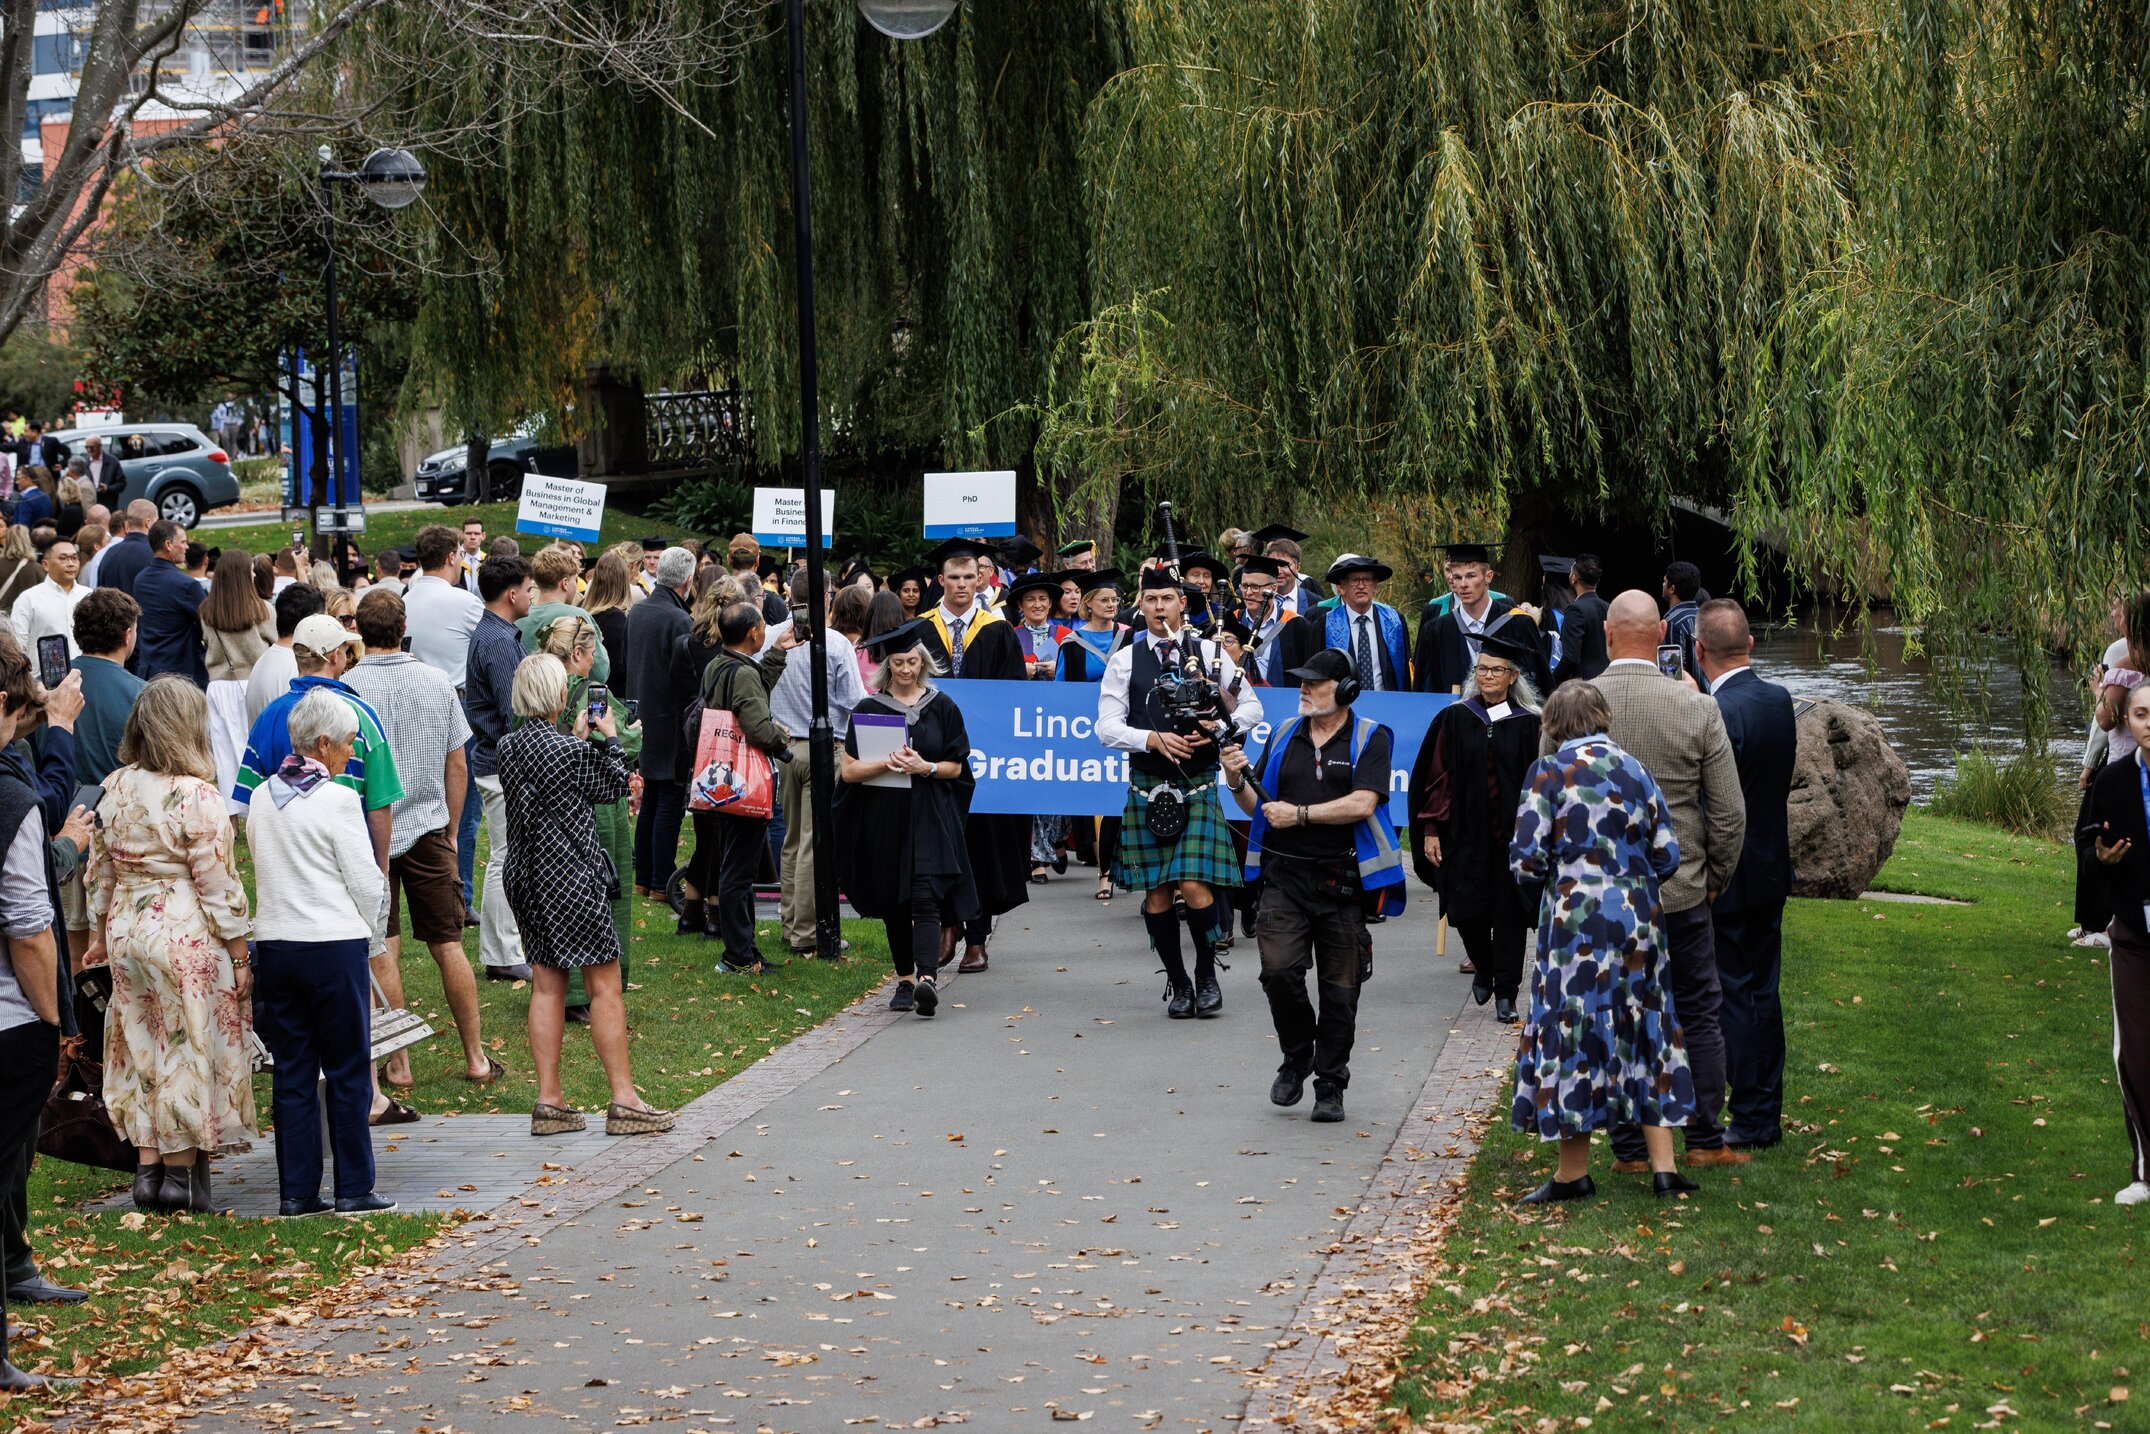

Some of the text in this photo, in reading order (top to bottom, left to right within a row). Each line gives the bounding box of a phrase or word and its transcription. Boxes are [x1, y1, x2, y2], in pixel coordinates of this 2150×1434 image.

[545, 482, 585, 495] Master of
[525, 488, 562, 502] Business
[573, 496, 600, 507] Global
[774, 498, 802, 507] Master
[962, 495, 978, 503] PhD
[529, 499, 593, 516] Management &
[775, 507, 806, 516] Busines
[538, 511, 581, 525] Marketing
[772, 517, 806, 526] in Financ
[1013, 706, 1099, 739] Linc
[967, 748, 1130, 783] Graduati
